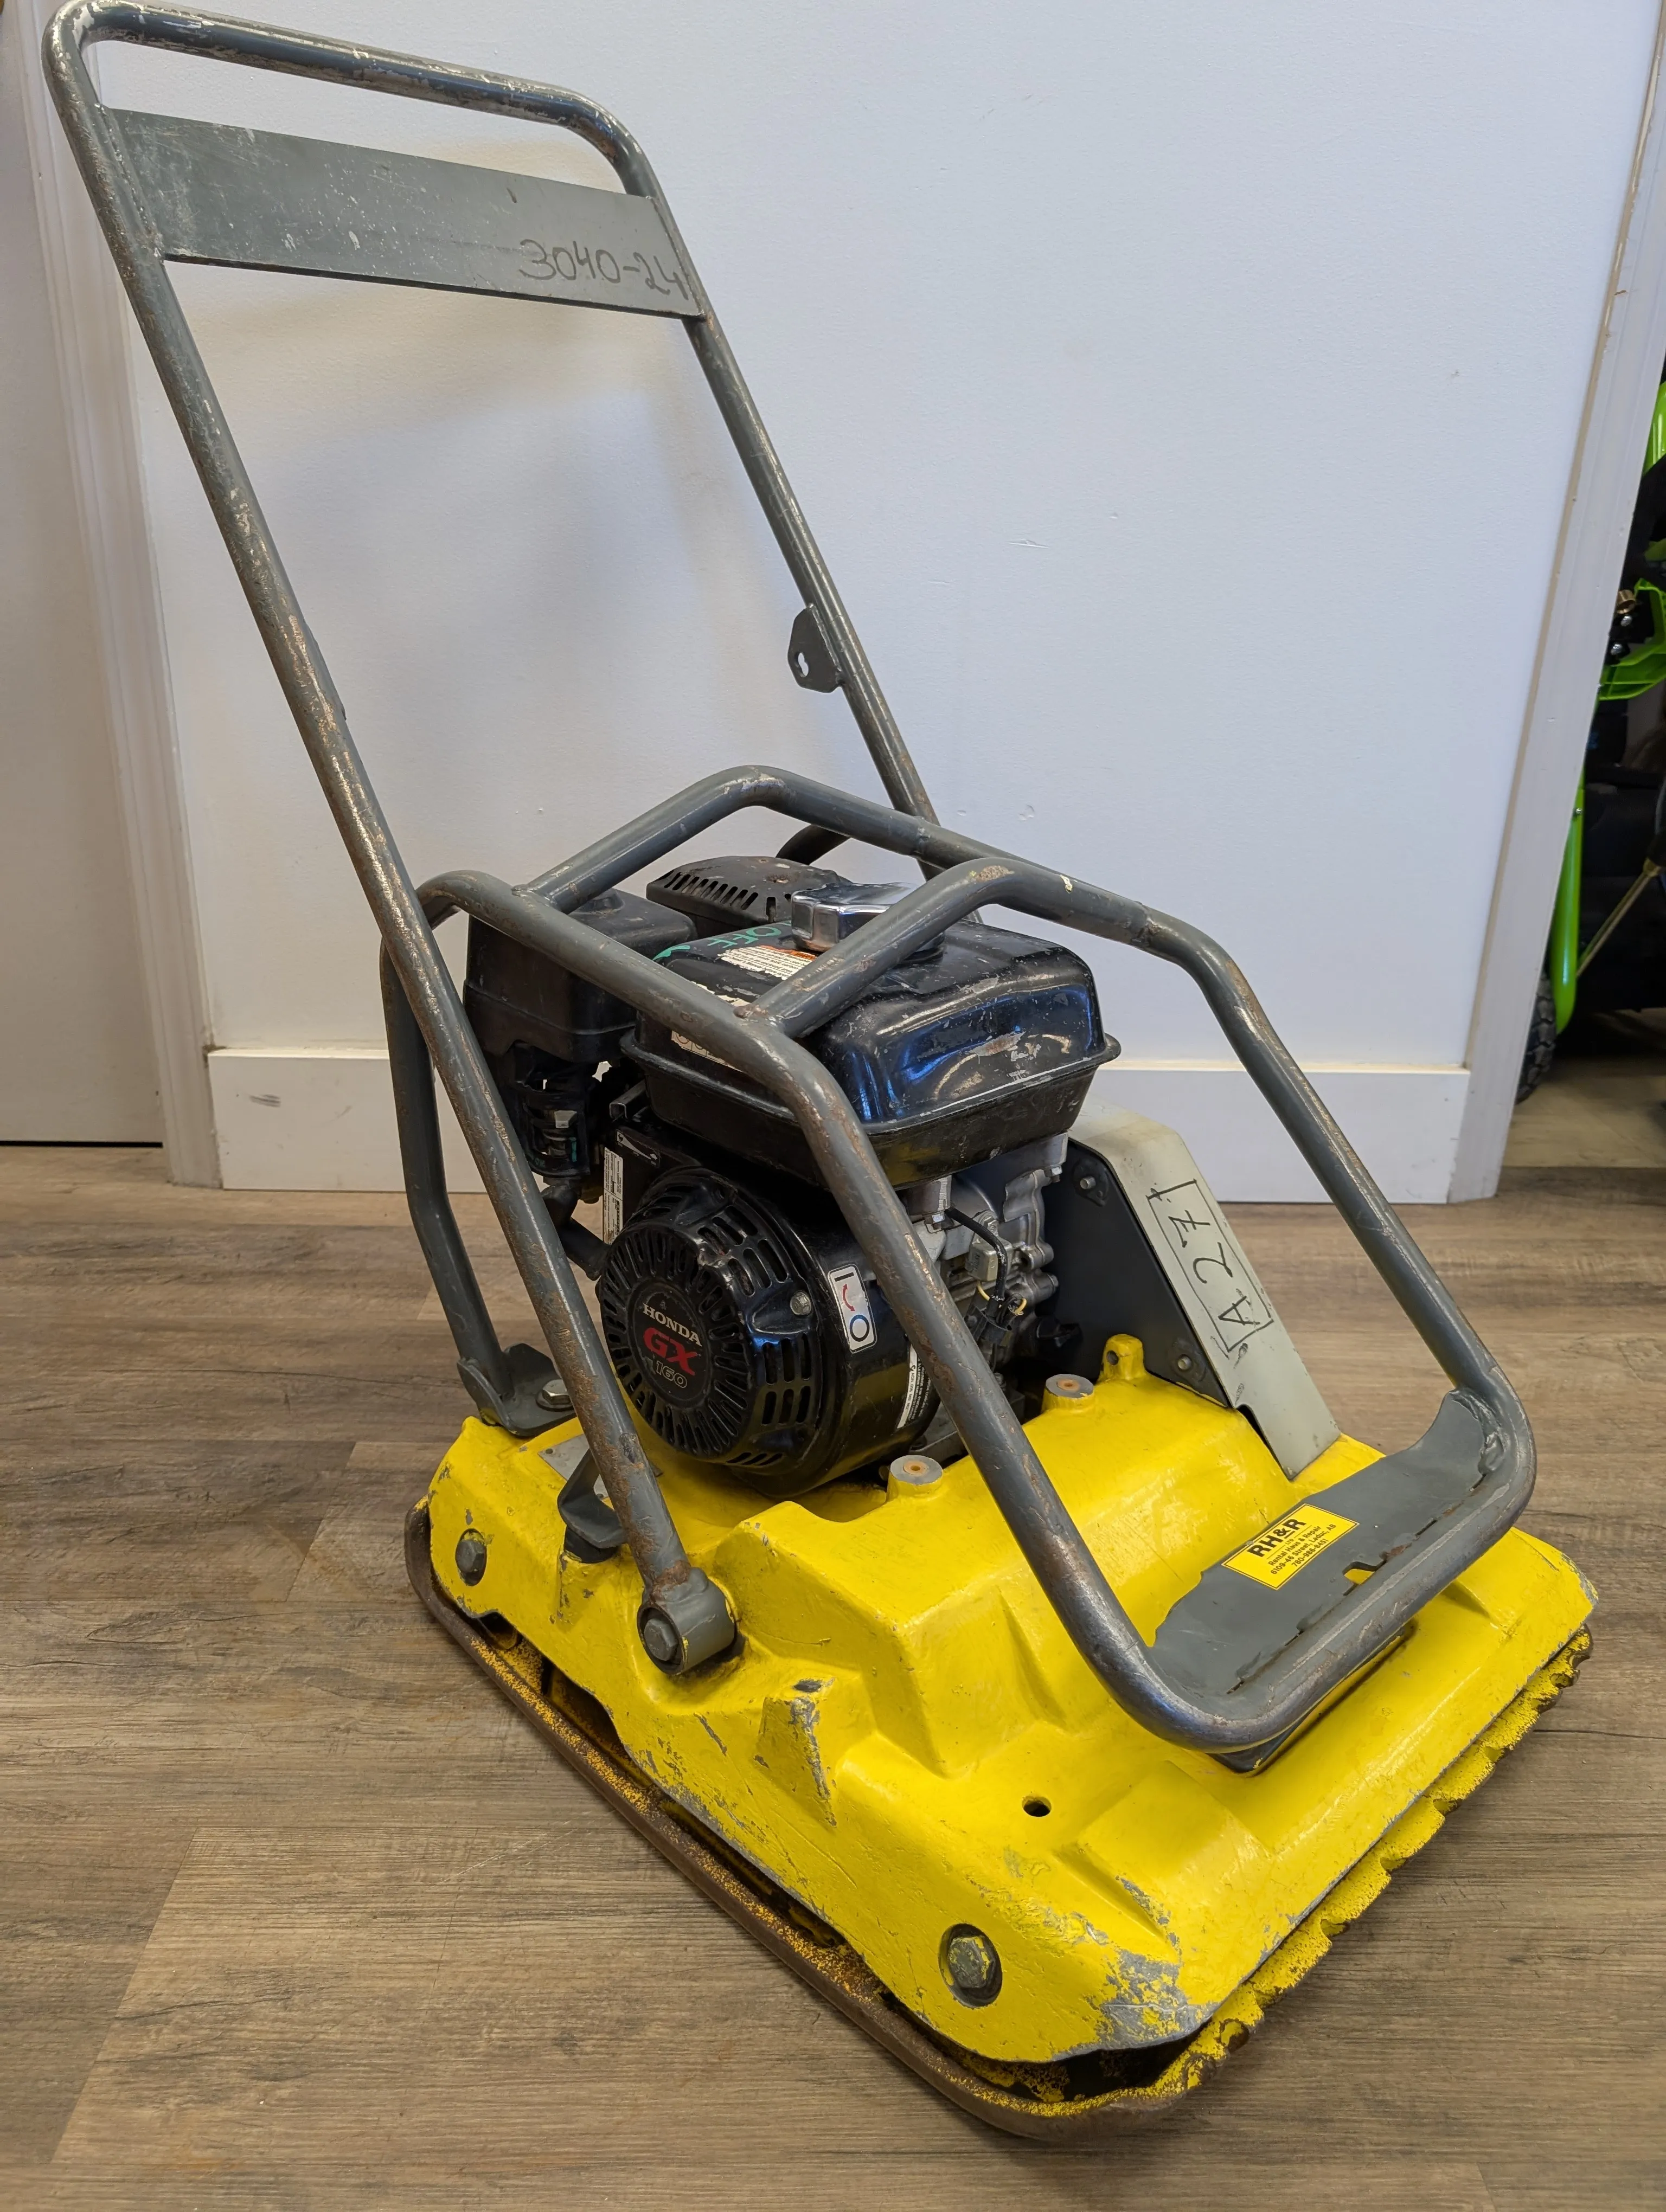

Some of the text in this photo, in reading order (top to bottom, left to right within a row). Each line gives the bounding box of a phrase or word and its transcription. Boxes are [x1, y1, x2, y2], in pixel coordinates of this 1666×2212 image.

[518, 239, 689, 300] 3040-24
[1168, 1210, 1260, 1326] A27
[643, 1303, 702, 1347] HONDA
[643, 1327, 697, 1376] GX
[656, 1360, 687, 1388] 160
[1247, 1519, 1306, 1557] RH&R
[1268, 1548, 1288, 1566] Rental
[1286, 1540, 1300, 1552] Haus
[1303, 1526, 1322, 1540] Repair
[1271, 1555, 1294, 1574] 6109-46
[1293, 1542, 1312, 1557] Street,
[1310, 1530, 1329, 1544] Leduc,
